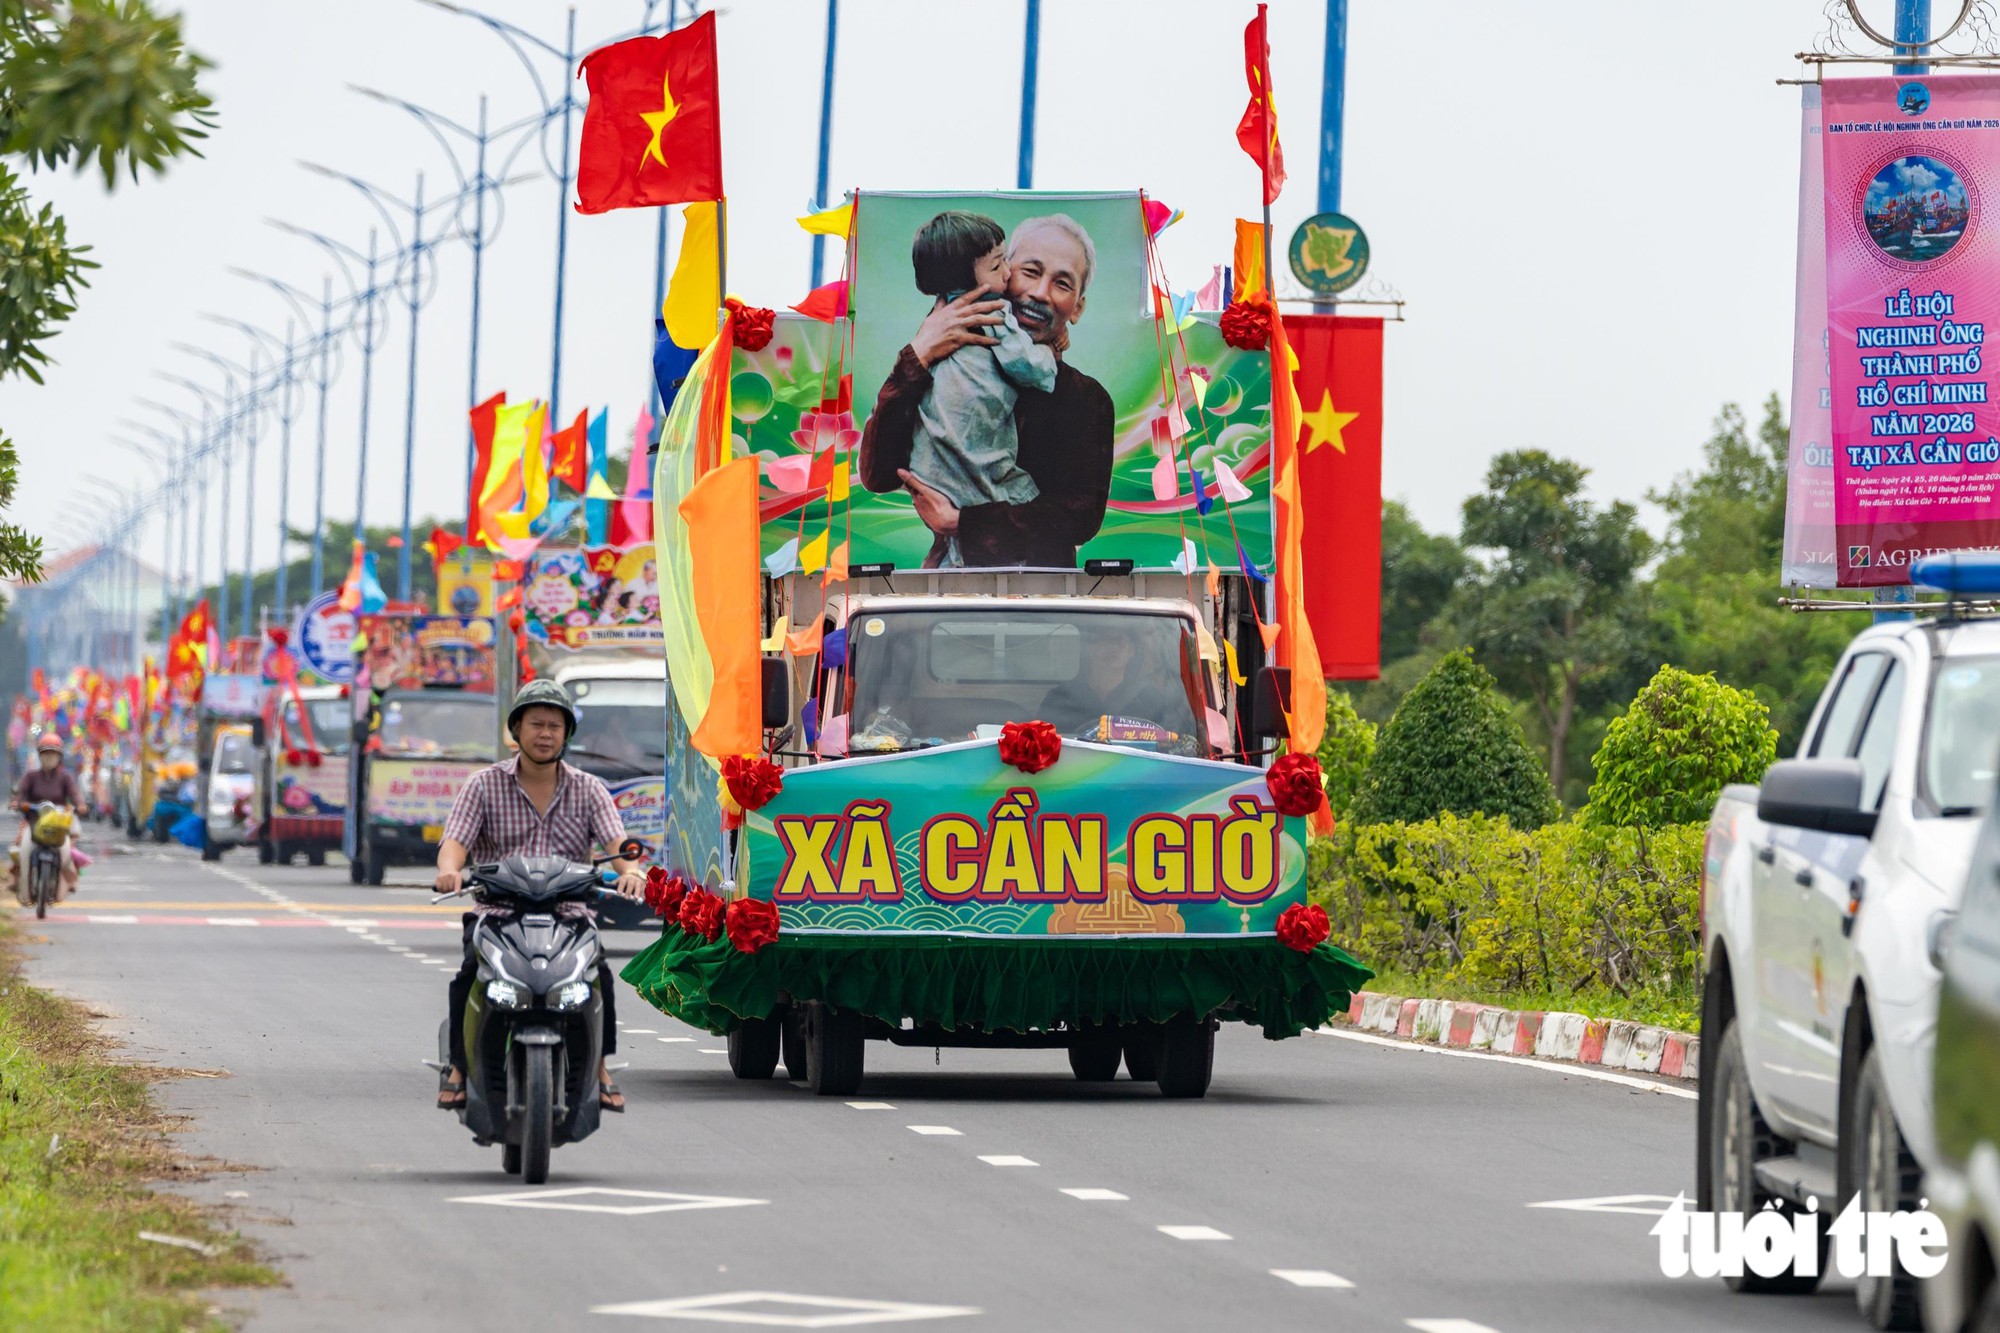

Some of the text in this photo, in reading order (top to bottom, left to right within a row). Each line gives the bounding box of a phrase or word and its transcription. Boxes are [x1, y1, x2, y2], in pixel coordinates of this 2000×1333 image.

[1829, 124, 1843, 133] BAN
[1896, 122, 1921, 132] NGHINH
[1983, 119, 2000, 128] 2026
[1886, 289, 1954, 320] LỄ HỘI
[1857, 320, 1984, 348] NGHINH ÔNG
[1861, 346, 1982, 377] THÀNH PHỐ
[1858, 379, 1988, 407] HỒ CHÍ MINH
[1872, 411, 1975, 436] NĂM 2026
[1847, 437, 2000, 471] TẠI XÃ CẦN GIỜ
[1929, 475, 1939, 483] 26
[1961, 474, 1967, 482] 9
[1960, 484, 1966, 492] 8
[775, 787, 1284, 904] XÃ CẦN GIỜ
